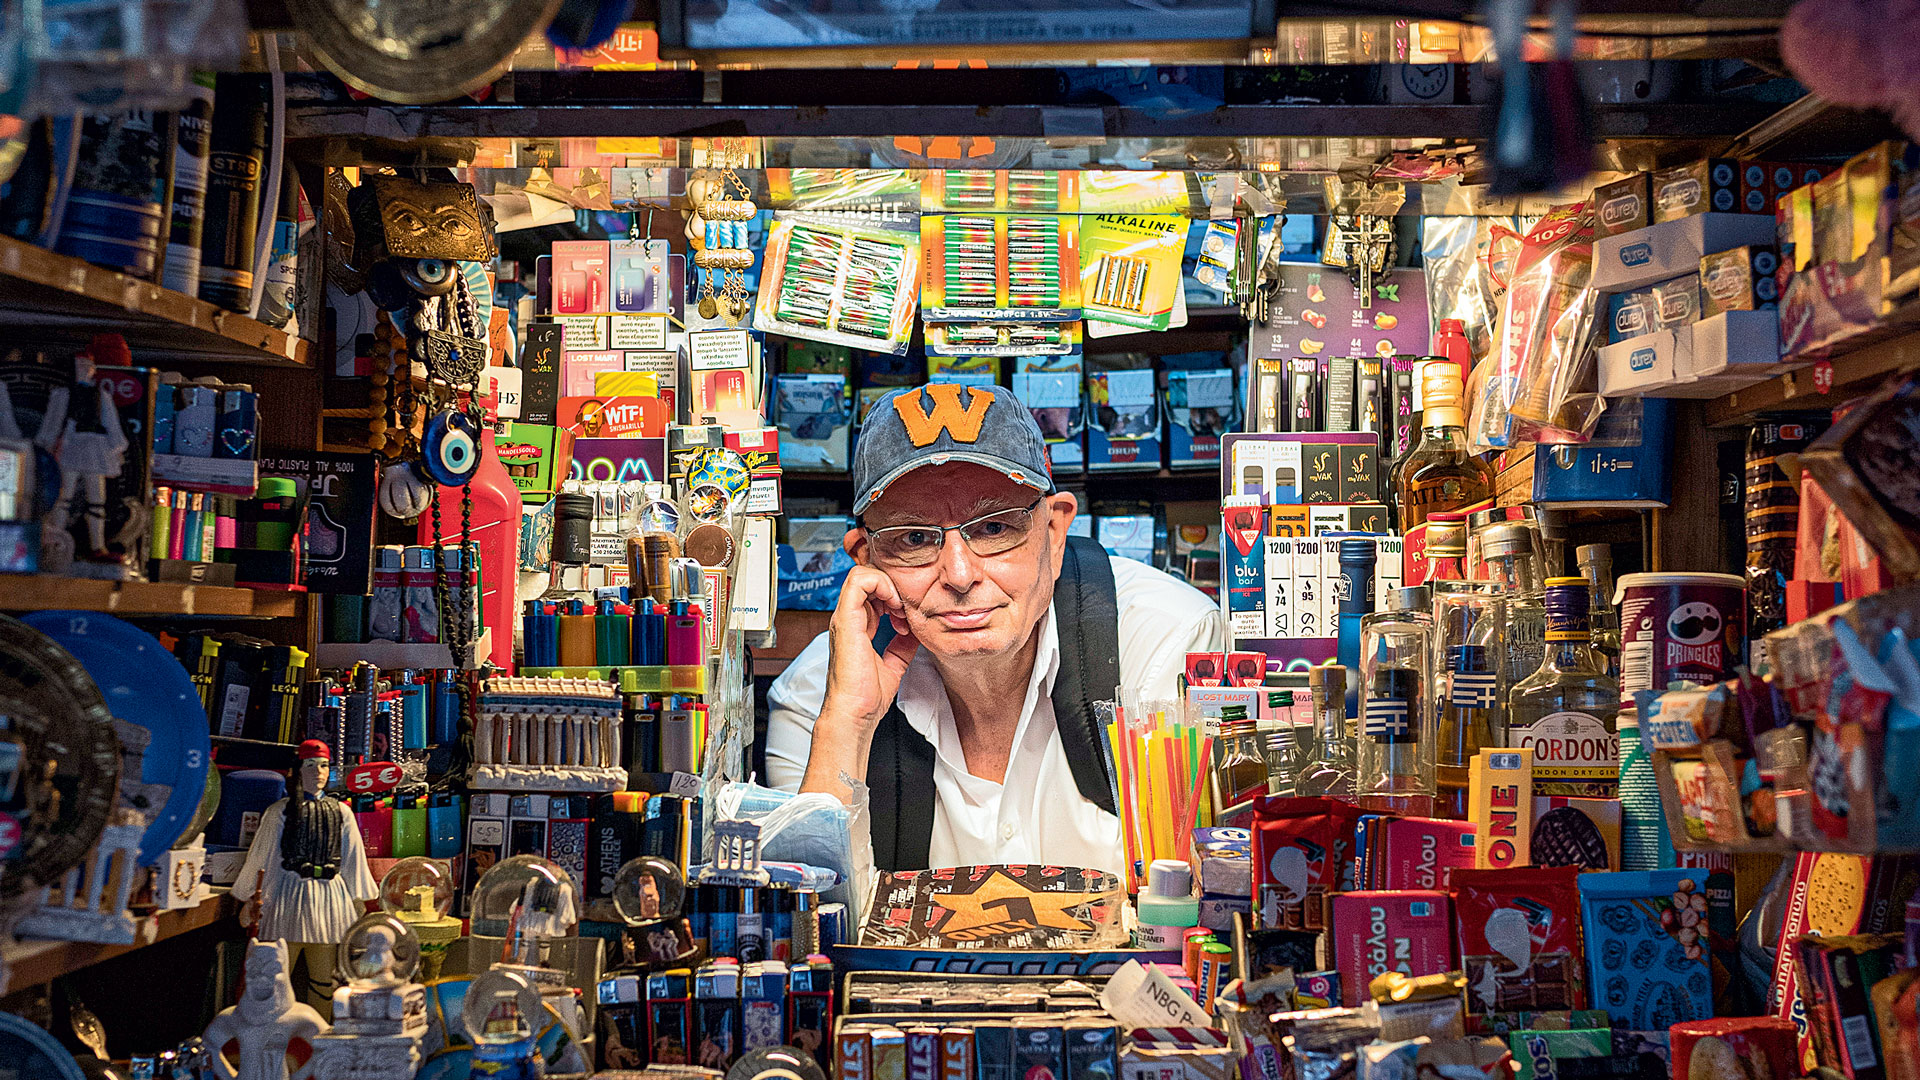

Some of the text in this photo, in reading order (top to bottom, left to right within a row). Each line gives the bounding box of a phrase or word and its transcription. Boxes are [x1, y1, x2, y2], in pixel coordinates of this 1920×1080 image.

[213, 157, 257, 174] STR8
[1604, 201, 1638, 219] durex
[1096, 213, 1176, 233] ALKALINE
[1531, 224, 1570, 243] 10€
[1620, 248, 1650, 264] durex
[1274, 306, 1284, 316] 12
[1352, 310, 1363, 319] 34
[1663, 301, 1689, 317] durex
[1619, 311, 1644, 327] durex
[1272, 334, 1282, 344] 13
[1351, 338, 1361, 348] 44
[571, 354, 618, 362] LOST MARY
[1631, 352, 1655, 367] durex
[604, 404, 644, 426] WTF!
[893, 383, 996, 447] W
[609, 422, 645, 433] SHISHARILLO
[498, 446, 537, 455] HANDELSGOLD
[1107, 446, 1141, 456] DRUM
[278, 458, 355, 474] PLASTIC ALL 100%
[1309, 472, 1333, 483] myVAK
[1347, 473, 1371, 484] myVAK
[1308, 490, 1334, 502] TOBACCO
[1347, 490, 1372, 502] TOBACCO
[1269, 542, 1291, 555] 1200
[1295, 542, 1319, 555] 1200
[1380, 541, 1402, 554] 1200
[1234, 564, 1259, 577] blu.
[788, 576, 835, 592] Dentyne
[1238, 577, 1255, 585] bar
[1275, 596, 1287, 606] 74
[1301, 591, 1315, 601] 95
[70, 617, 88, 635] 12
[1667, 641, 1721, 668] PRINGLES
[1196, 693, 1252, 702] LOST MARY
[187, 750, 201, 769] 3
[355, 766, 399, 790] 5 €
[675, 773, 698, 789] 120
[1488, 783, 1519, 869] ONE
[600, 827, 614, 874] ATHENS
[1706, 888, 1733, 901] PIZZA
[945, 918, 1037, 942] ONLY
[1138, 934, 1166, 945] CLEANER
[1146, 981, 1182, 1018] NBG
